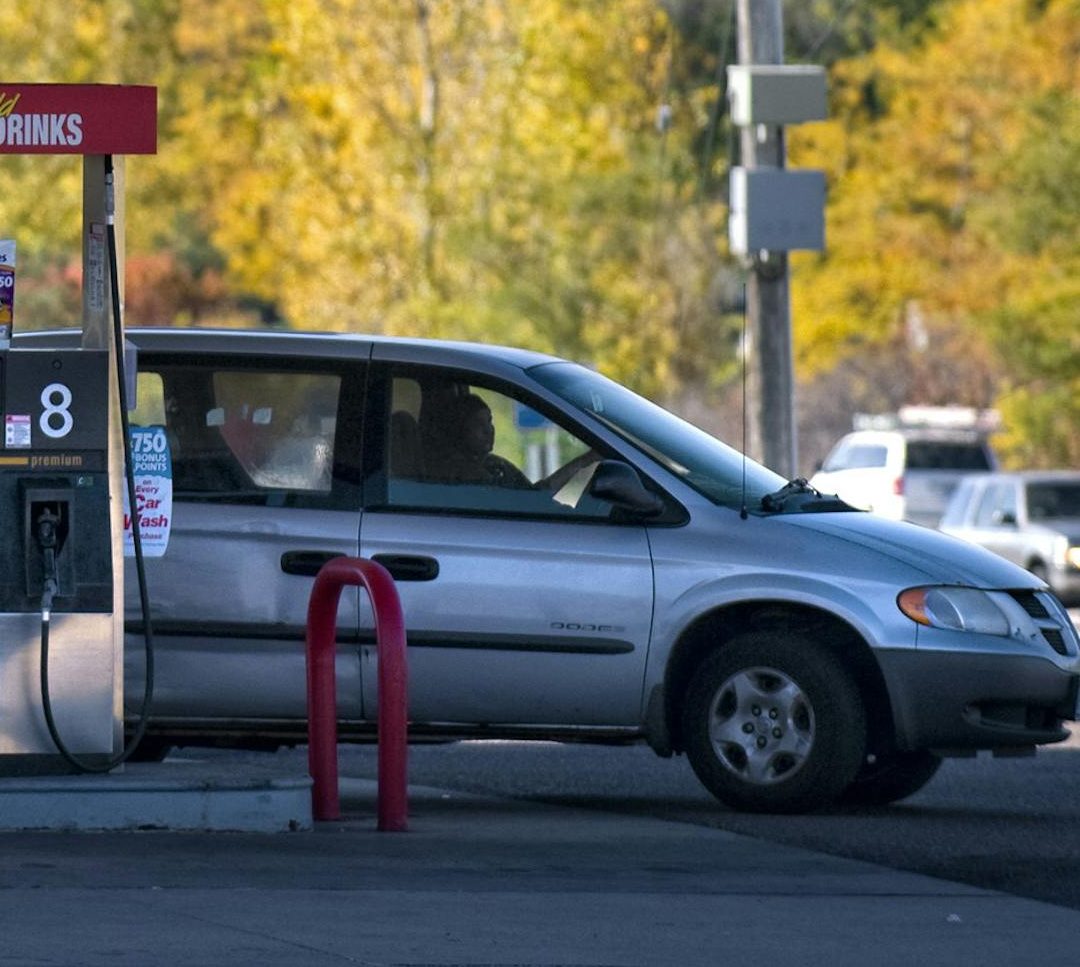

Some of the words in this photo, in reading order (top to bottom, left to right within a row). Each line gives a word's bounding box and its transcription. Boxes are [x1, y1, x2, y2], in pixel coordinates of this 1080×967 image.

[40, 383, 74, 438] 8
[132, 433, 167, 453] 750
[31, 454, 82, 468] premium
[135, 453, 167, 462] BONUS
[134, 462, 167, 472] POINTS
[135, 485, 159, 494] Every
